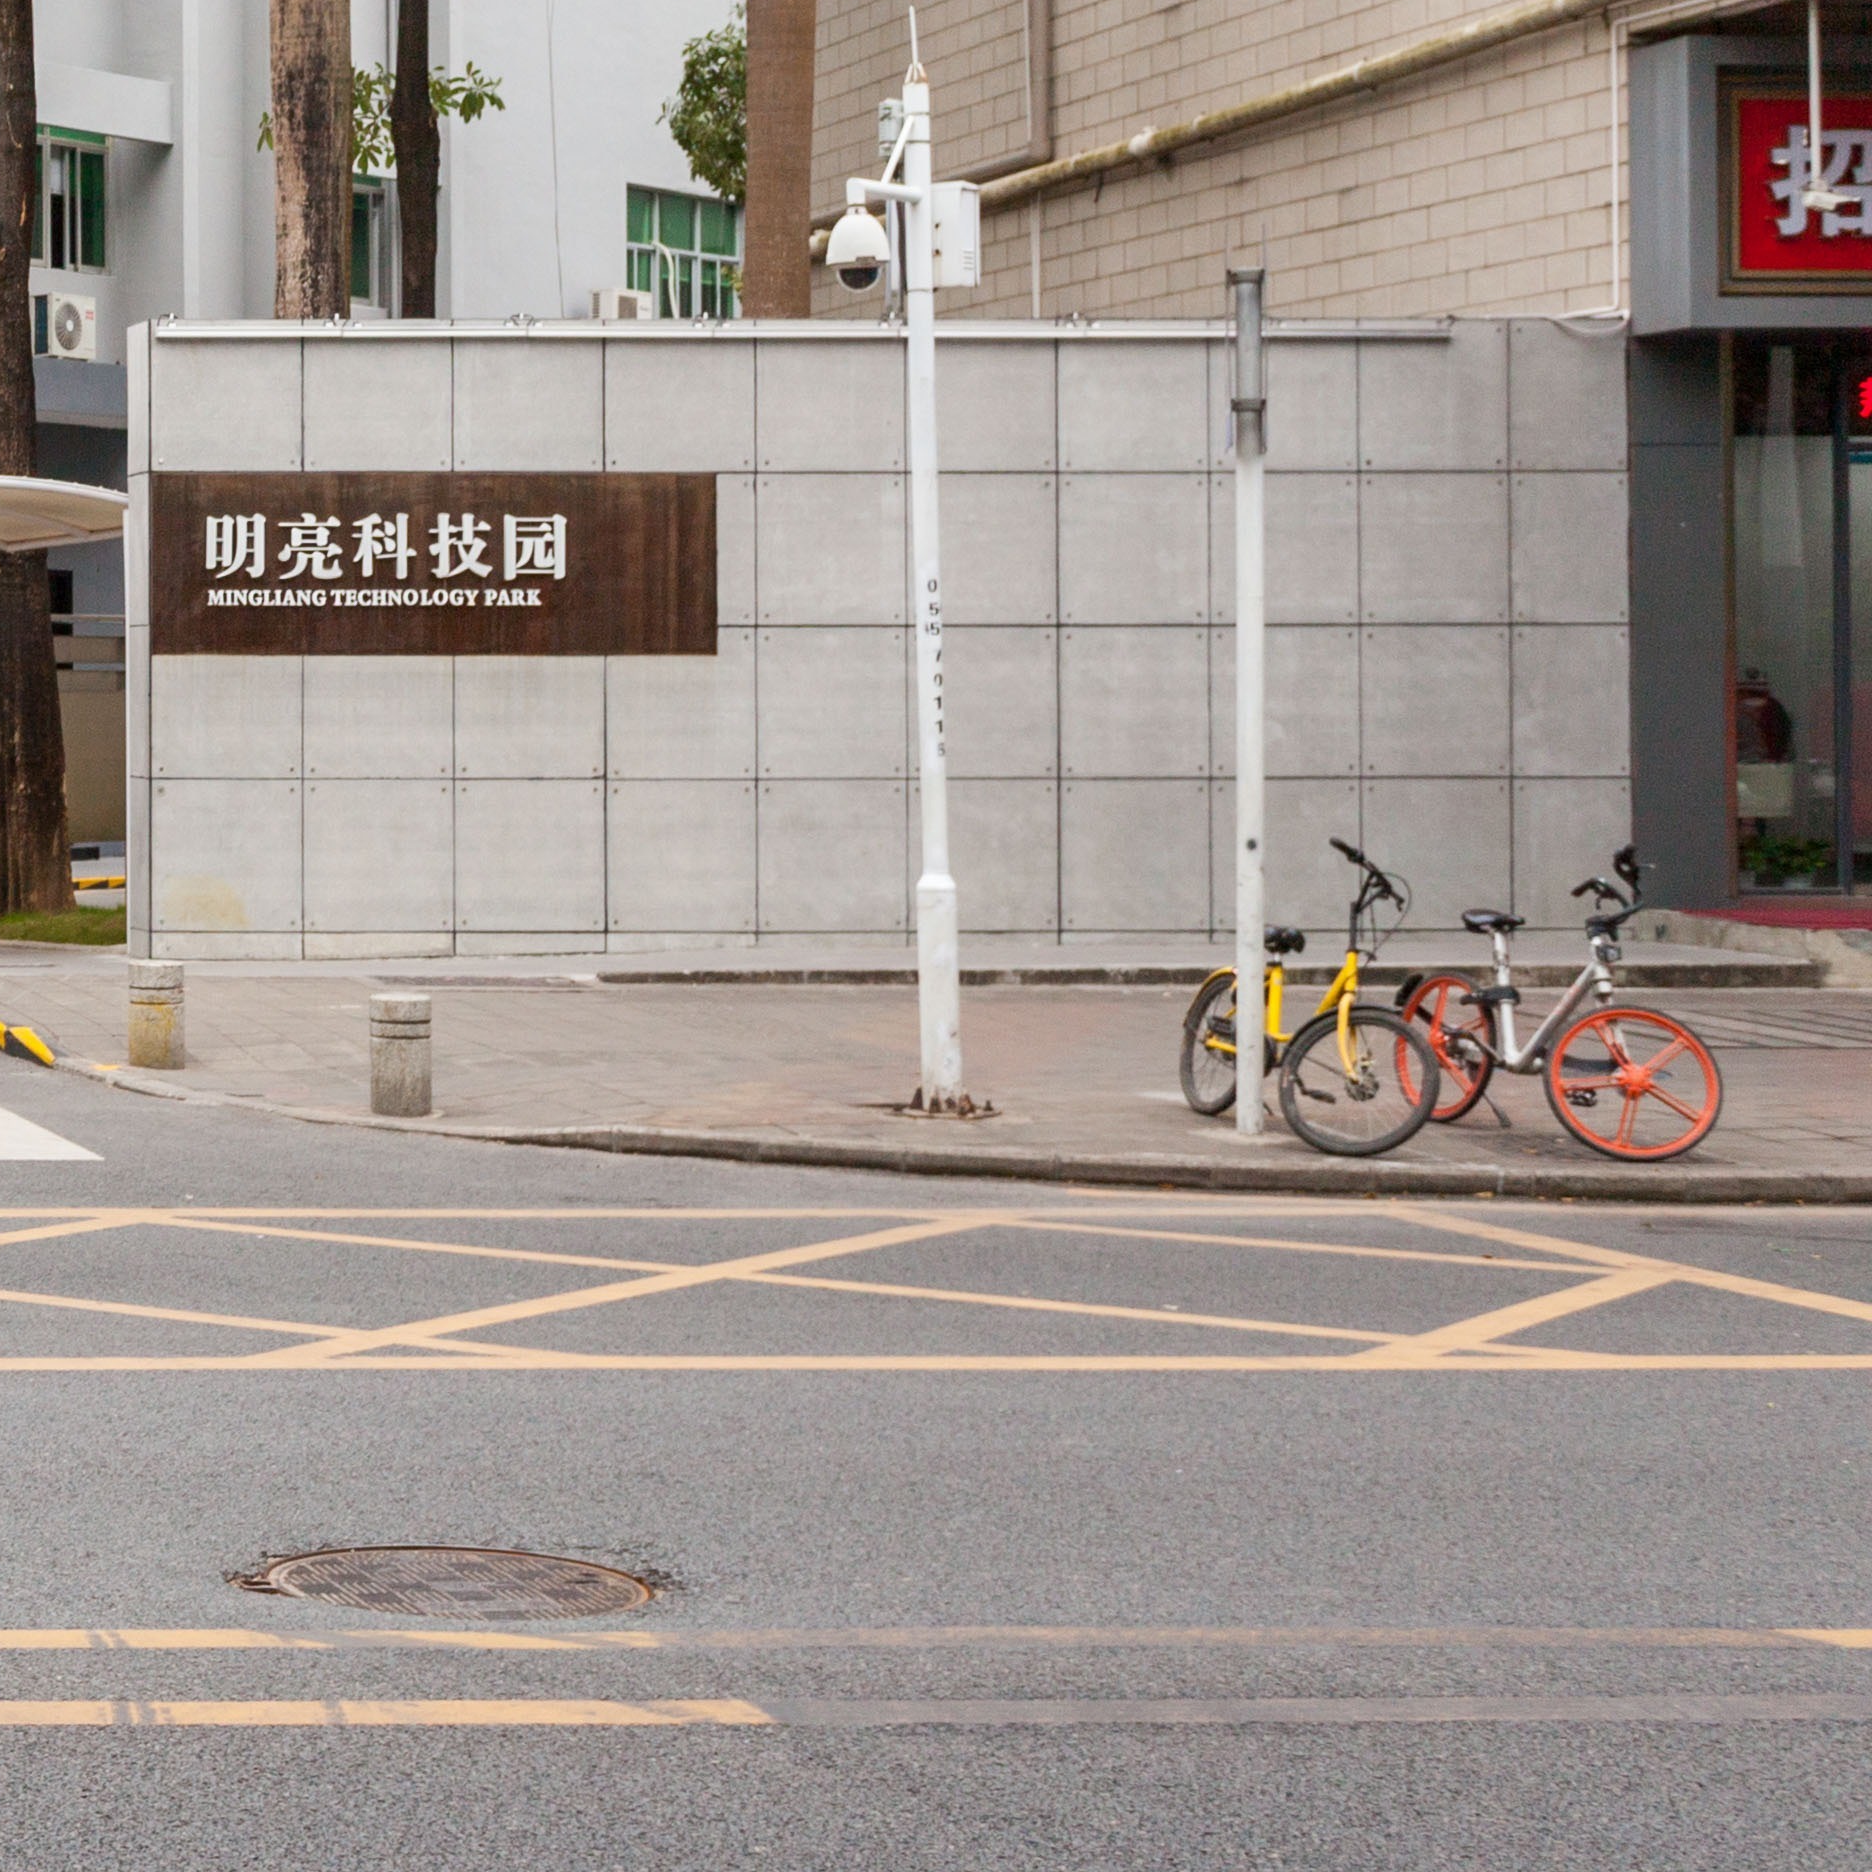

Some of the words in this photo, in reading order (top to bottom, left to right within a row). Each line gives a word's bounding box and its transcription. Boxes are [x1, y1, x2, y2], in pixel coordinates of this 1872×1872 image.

[205, 512, 568, 581] 明亮科技园
[207, 589, 327, 607] MINGLIANG
[331, 589, 480, 607] TECHNOLOGY
[484, 589, 542, 607] PARK
